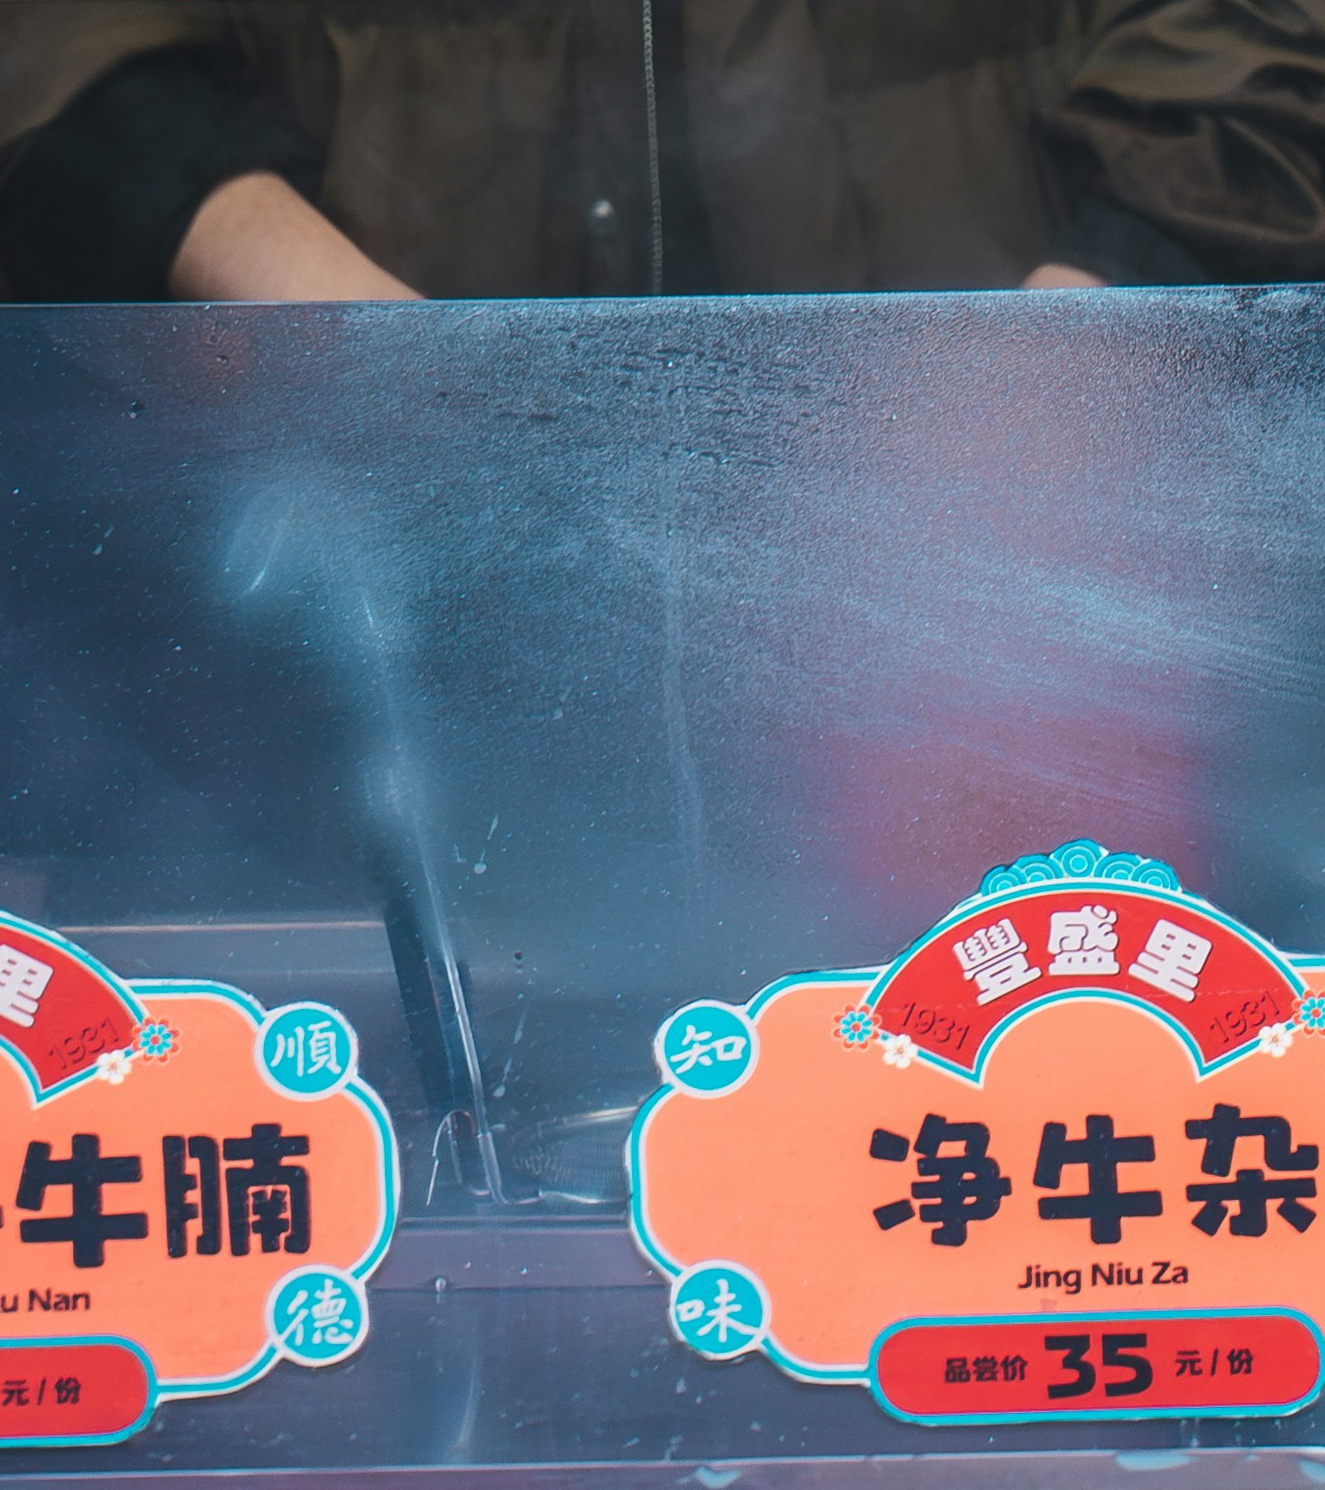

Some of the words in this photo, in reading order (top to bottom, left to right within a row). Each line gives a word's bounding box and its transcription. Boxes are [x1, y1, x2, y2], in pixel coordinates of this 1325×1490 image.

[953, 904, 1213, 1005] 豐盛里
[273, 1023, 346, 1079] 順
[672, 1024, 747, 1073] 知
[869, 1102, 1320, 1247] 净牛杂
[28, 1289, 90, 1312] Nan
[1019, 1266, 1082, 1295] Jing
[1091, 1263, 1143, 1286] Niu
[1152, 1261, 1189, 1285] Za
[283, 1286, 354, 1347] 德
[675, 1280, 759, 1343] 味
[944, 1353, 1027, 1384] 品尝价
[1043, 1333, 1154, 1397] 35
[1175, 1350, 1253, 1378] 元/份
